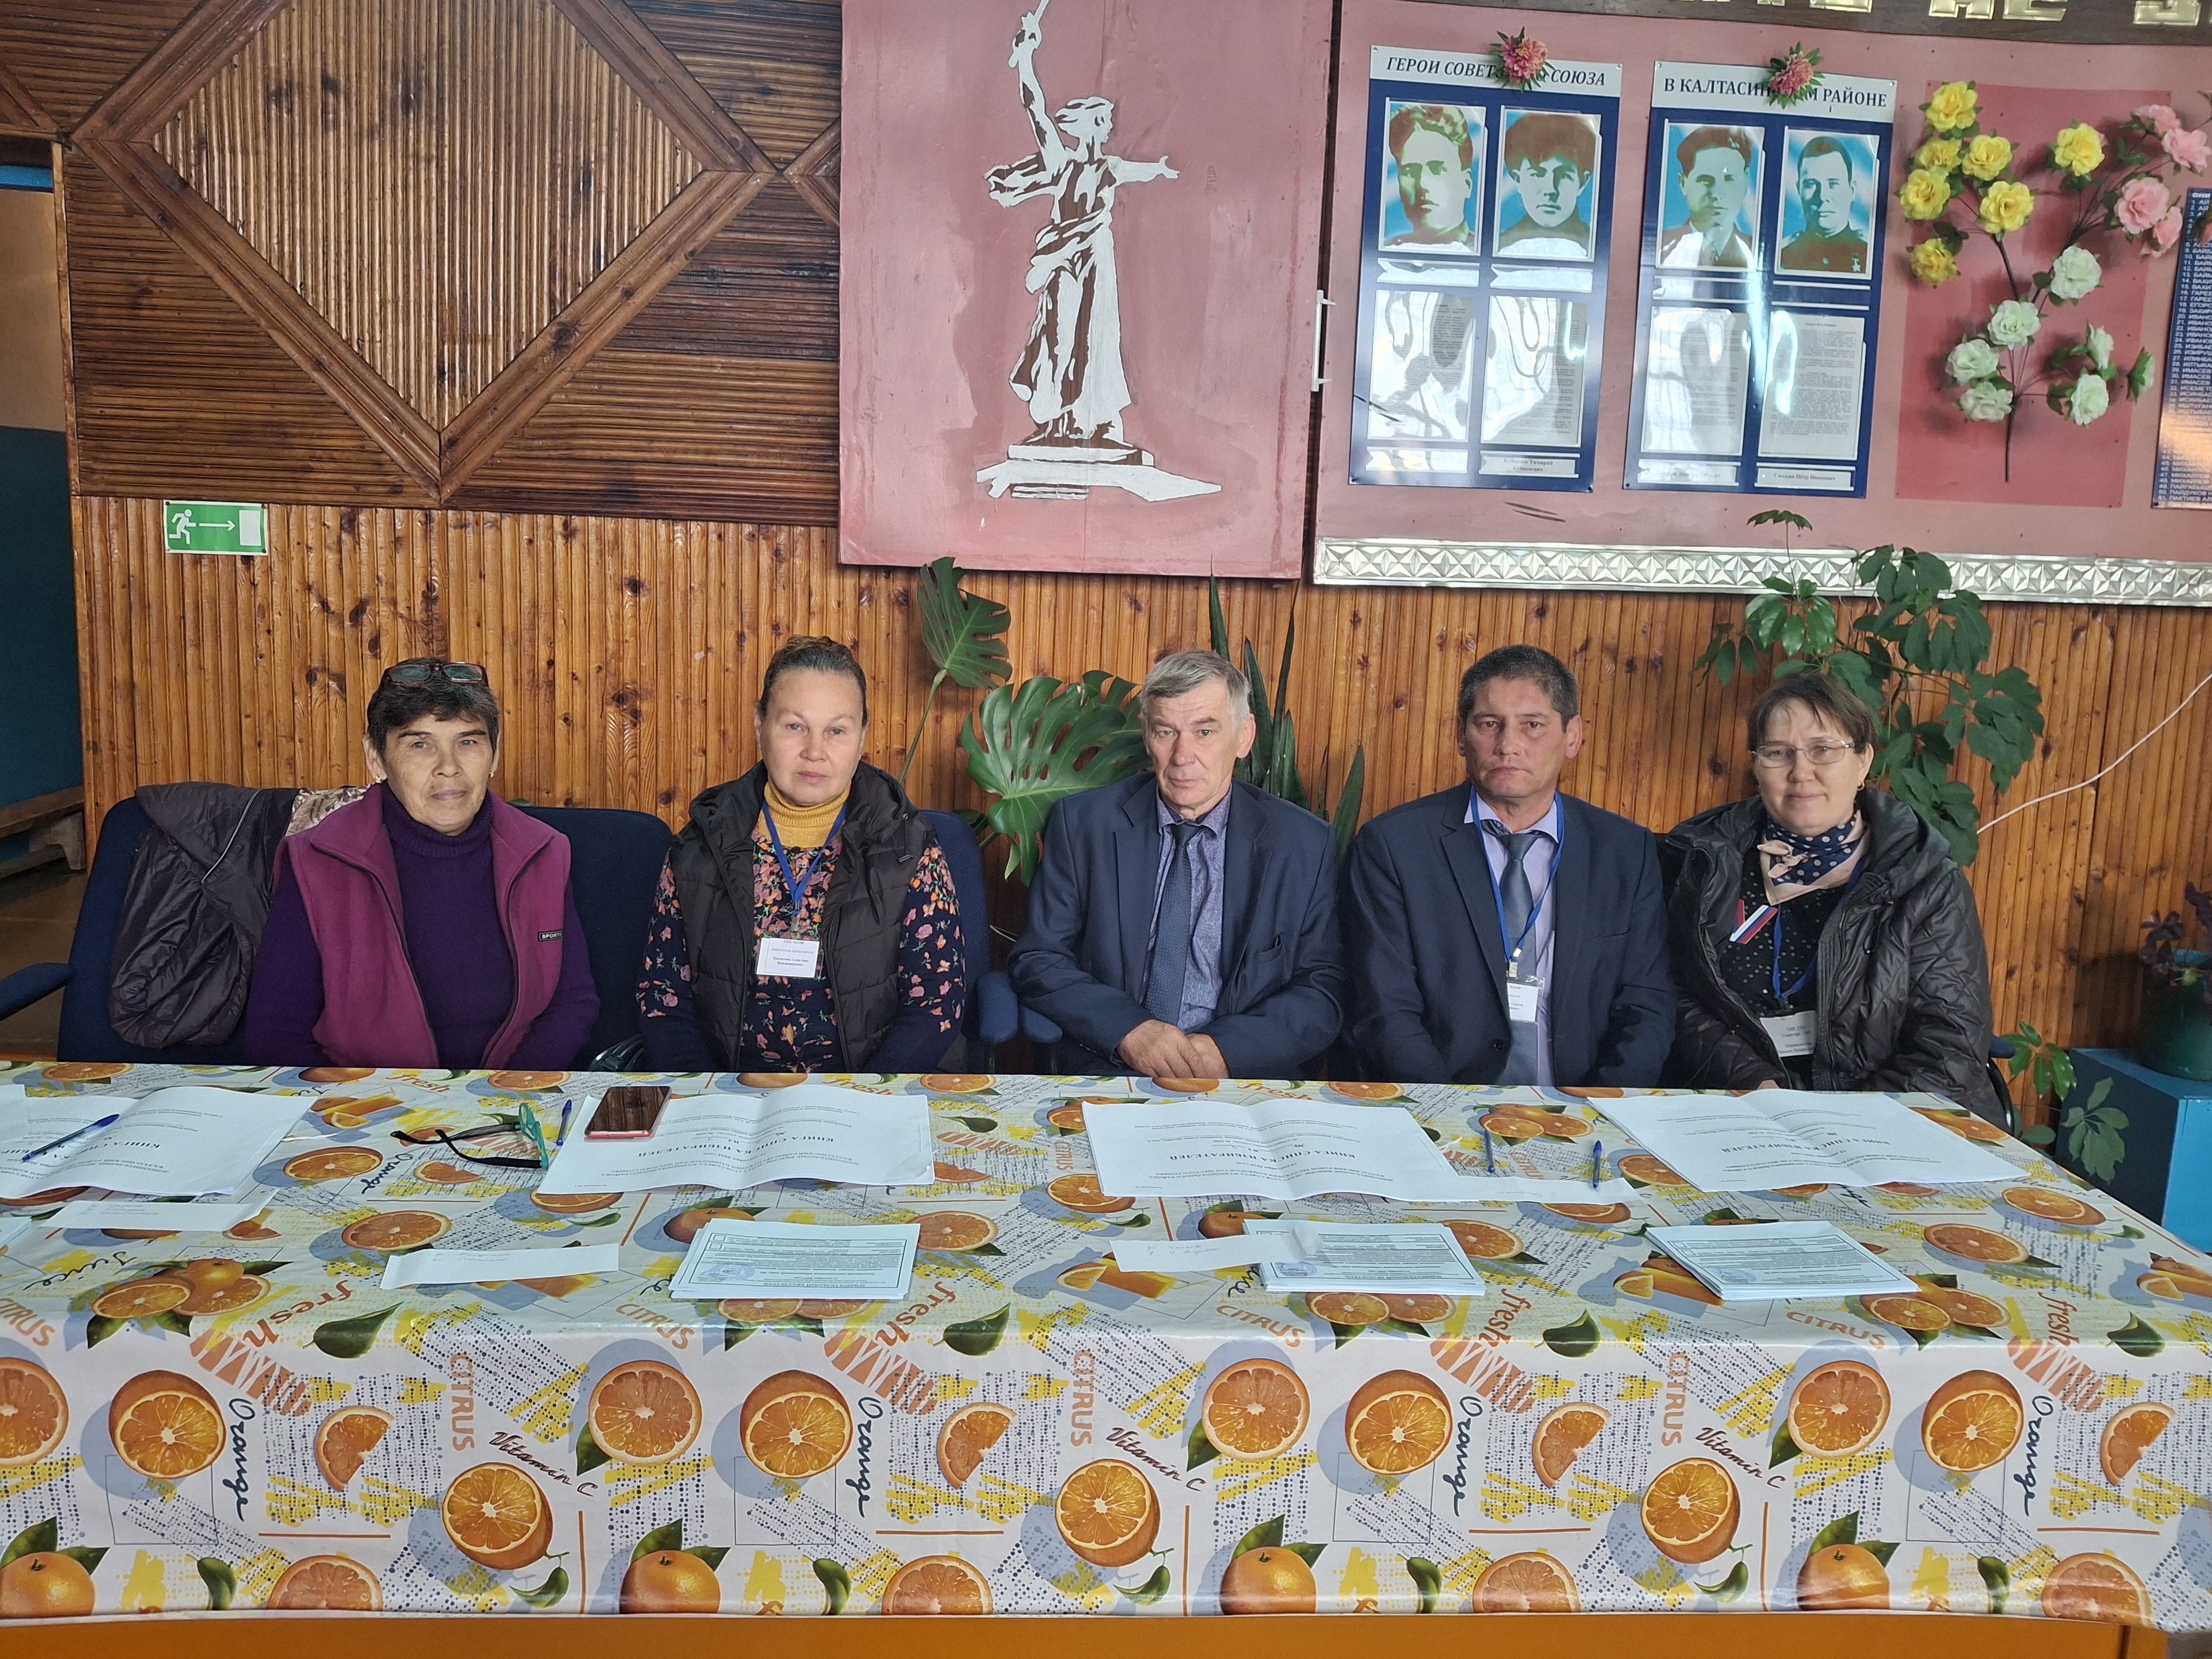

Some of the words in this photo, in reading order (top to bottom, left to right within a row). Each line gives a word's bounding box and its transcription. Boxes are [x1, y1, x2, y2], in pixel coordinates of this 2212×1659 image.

[1386, 56, 1441, 75] ГЕРОИ
[1551, 68, 1605, 86] СОЮЗА
[1664, 78, 1675, 92] В
[1823, 87, 1887, 107] РАЙОНЕ
[1509, 1152, 1545, 1180] CITRU
[615, 1303, 696, 1350] CITRUS
[875, 1281, 956, 1347] fresh
[1216, 1304, 1307, 1348] CITRUS
[1478, 1288, 1533, 1348] fresh
[1786, 1310, 1887, 1351] CITRUS
[2039, 1291, 2079, 1348] fresh
[449, 1354, 475, 1451] CITRUS
[1070, 1349, 1096, 1446] CITRUS
[1661, 1352, 1690, 1447] CITRUS
[222, 1397, 255, 1522] Orange
[488, 1431, 572, 1486] Vitamin
[576, 1482, 599, 1497] C
[846, 1396, 883, 1517] Orange
[1105, 1426, 1182, 1482] Vitamin
[1186, 1477, 1207, 1493] C
[1443, 1395, 1483, 1517] Orange
[1694, 1426, 1763, 1480] Vitamin
[1766, 1475, 1787, 1489] C
[2013, 1395, 2054, 1516] Orange
